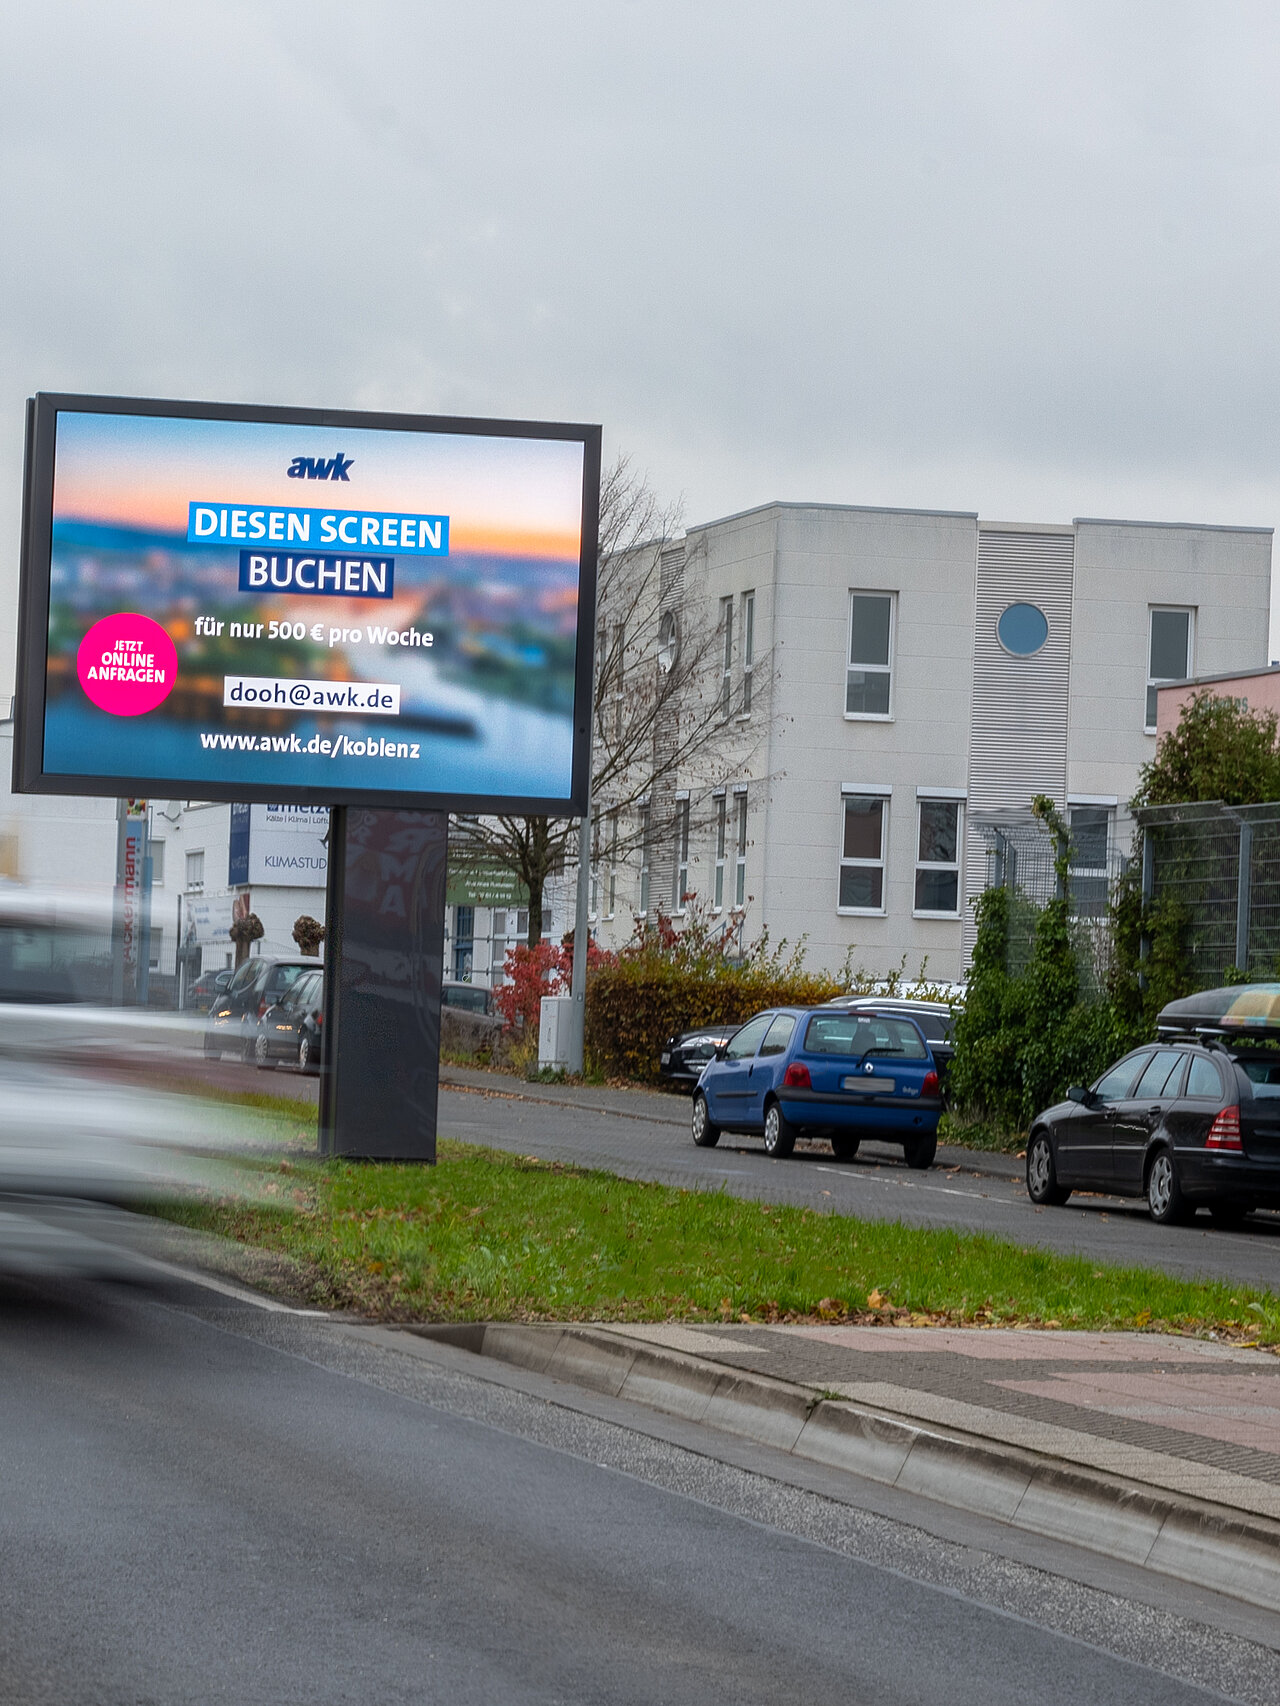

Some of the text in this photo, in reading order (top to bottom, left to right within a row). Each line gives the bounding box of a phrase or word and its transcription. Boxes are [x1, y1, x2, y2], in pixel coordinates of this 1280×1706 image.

[287, 453, 354, 481] awk
[195, 508, 442, 549] DIESEN SCREEN
[249, 556, 386, 593] BUCHEN
[195, 617, 434, 647] für nur 500 € pro Woche
[114, 640, 143, 651] JETZT
[101, 652, 154, 668] ONLINE
[87, 666, 165, 683] ANFRAGEN
[230, 682, 393, 708] dooh@awk.de
[201, 733, 420, 758] www.awk.de/koblenz
